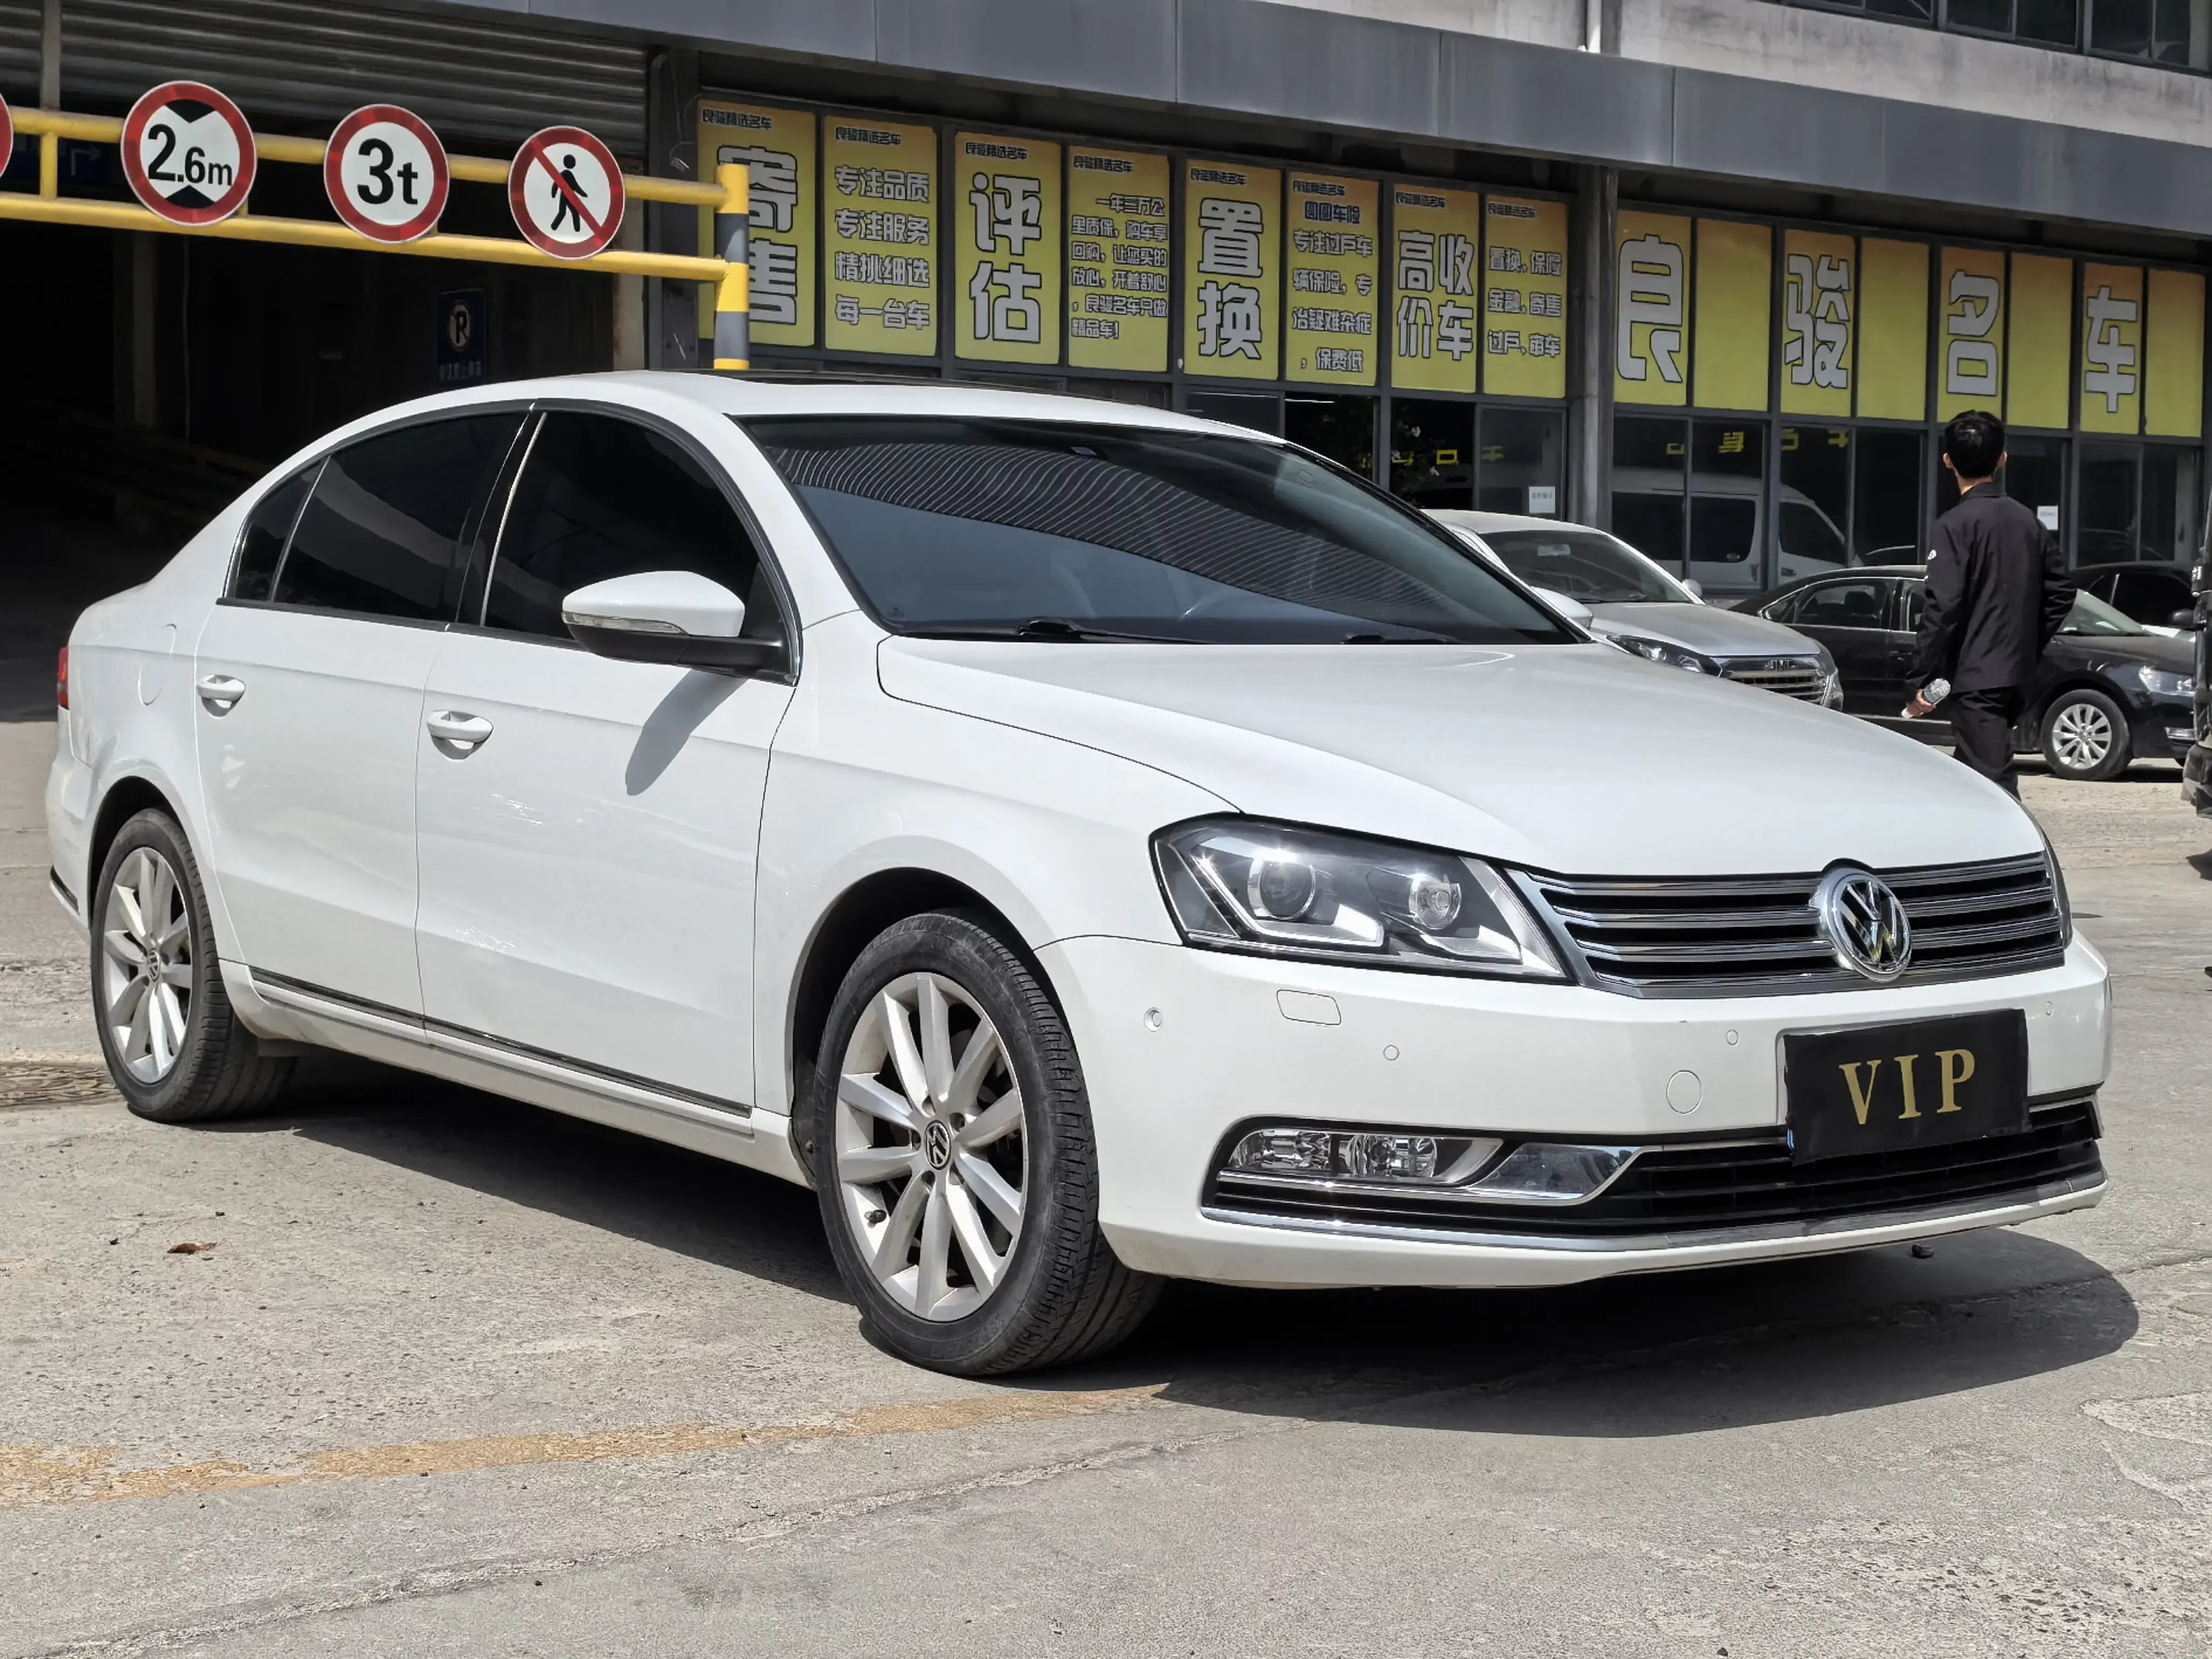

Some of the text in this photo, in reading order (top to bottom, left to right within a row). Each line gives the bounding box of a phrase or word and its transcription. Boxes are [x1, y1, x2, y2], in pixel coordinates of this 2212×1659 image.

[147, 122, 234, 187] 2.6m
[356, 137, 419, 205] 3t
[835, 164, 930, 203] 专注品质
[834, 208, 930, 246] 专注服务
[1293, 227, 1374, 258] 专注过户车
[834, 251, 930, 288] 精挑细选
[969, 172, 1042, 344] 评估
[1198, 198, 1264, 360] 置换
[835, 294, 930, 330] 每一台车
[1292, 307, 1372, 335] 治疑难杂症
[1838, 1048, 1976, 1126] VIP
